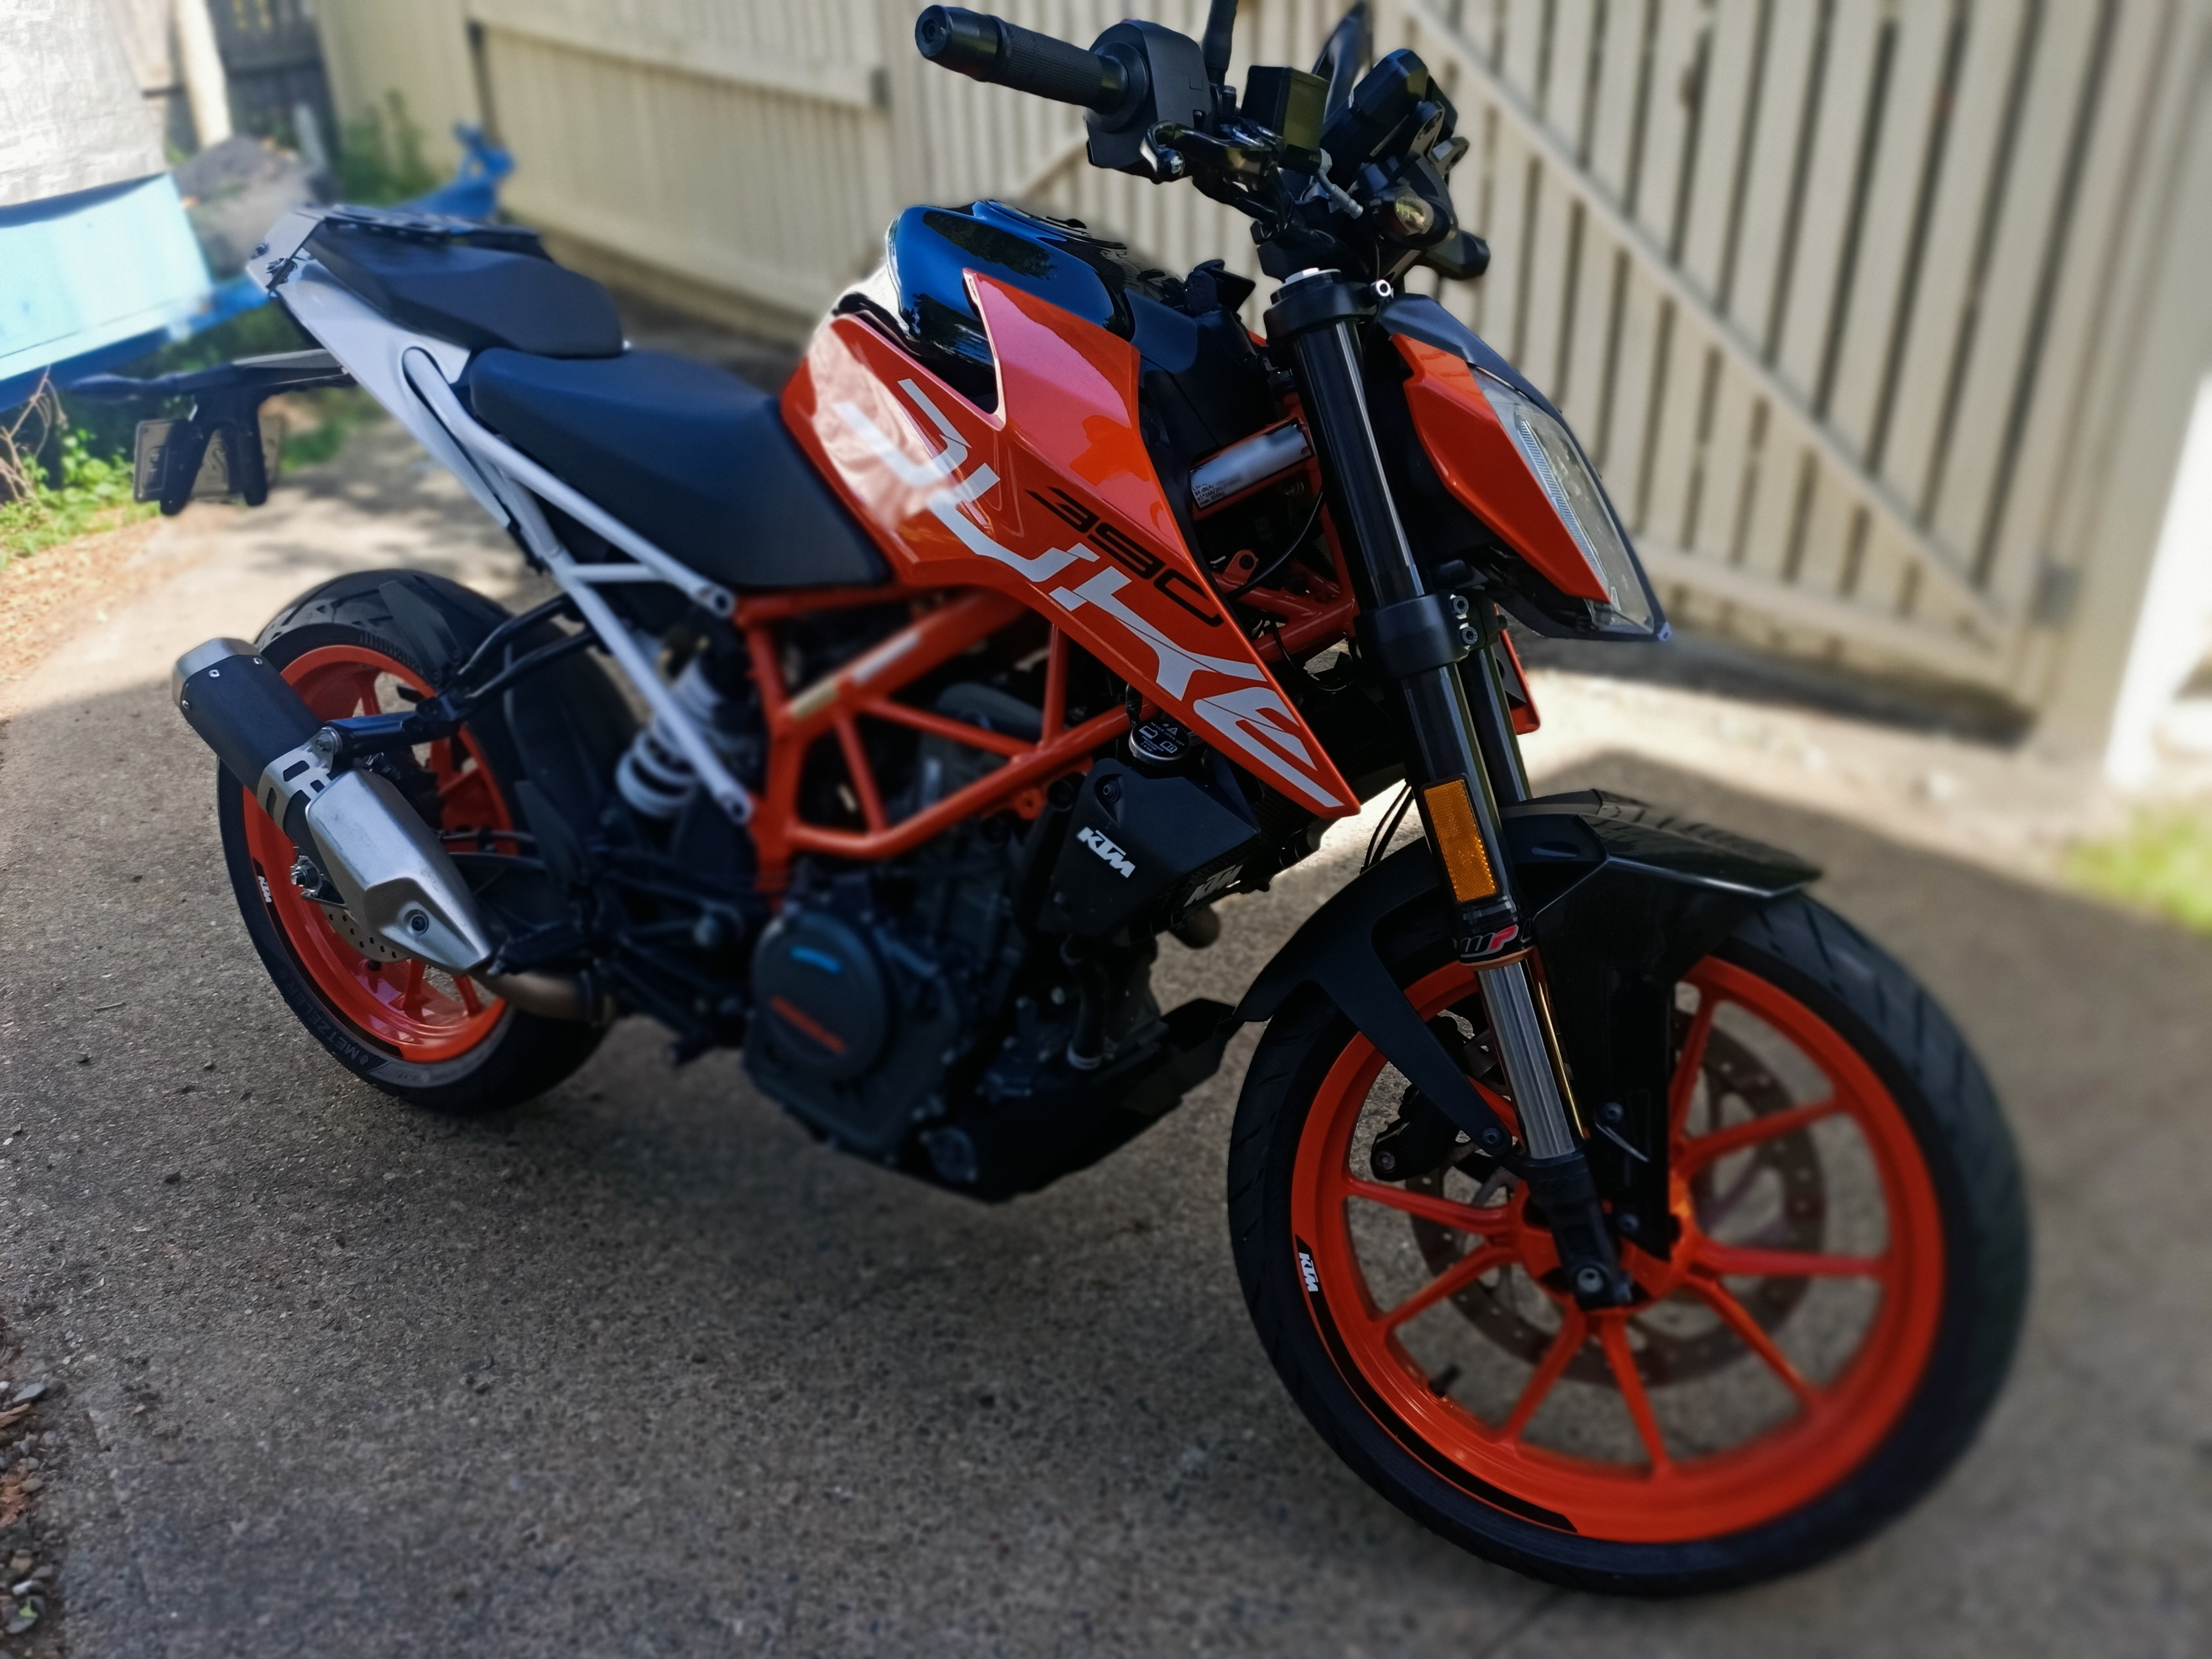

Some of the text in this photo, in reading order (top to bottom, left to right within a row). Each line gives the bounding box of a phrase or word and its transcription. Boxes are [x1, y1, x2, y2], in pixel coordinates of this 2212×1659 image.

[1025, 486, 1224, 627] 390
[1077, 826, 1136, 878] KTM
[258, 875, 272, 902] KTM
[1183, 864, 1244, 907] KTM
[286, 980, 359, 1060] METZELER
[1298, 1252, 1318, 1291] KTM
